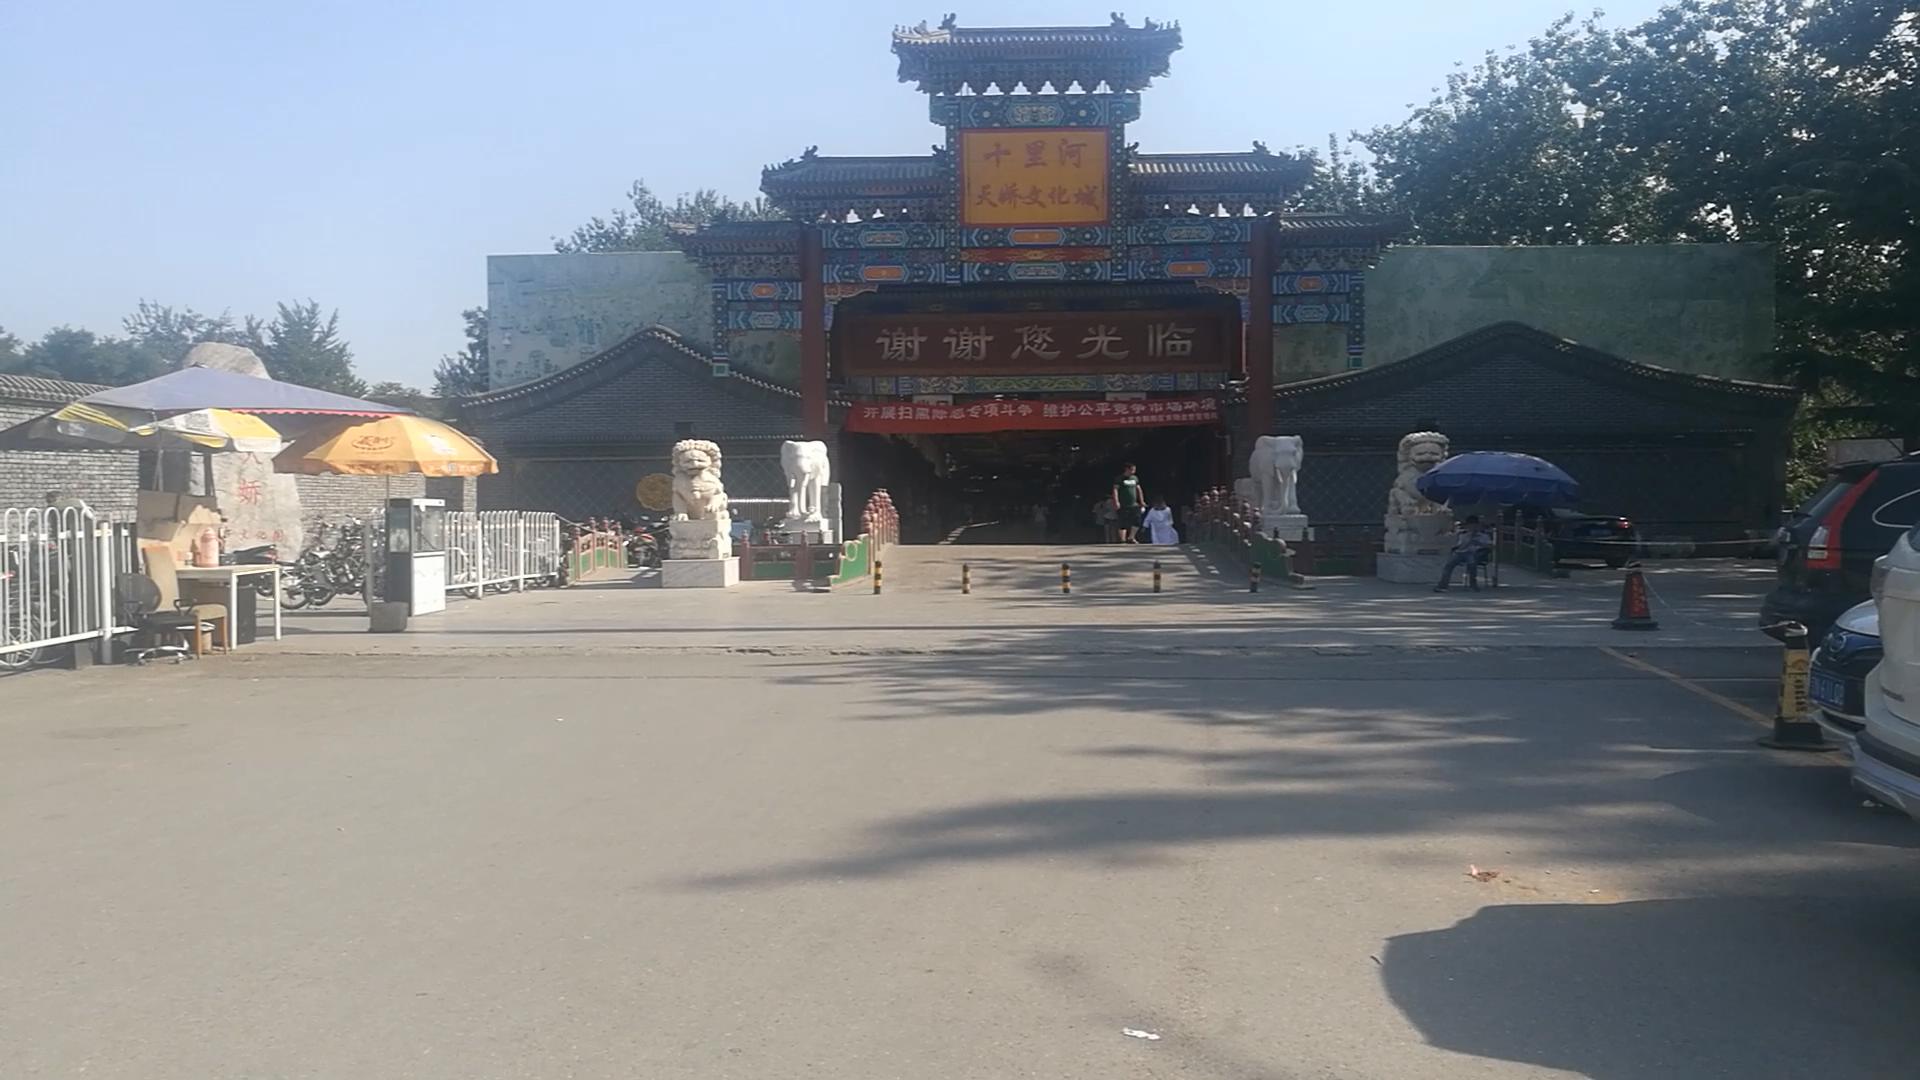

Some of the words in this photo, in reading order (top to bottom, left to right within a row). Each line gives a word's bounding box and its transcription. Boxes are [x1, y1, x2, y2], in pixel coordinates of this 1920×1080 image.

[983, 138, 1088, 168] 十里河
[876, 323, 1196, 361] 谢谢您光临
[863, 403, 1033, 421] 开展扫黑除恶专项斗争
[1043, 397, 1217, 417] 维护公平竞争市场环境
